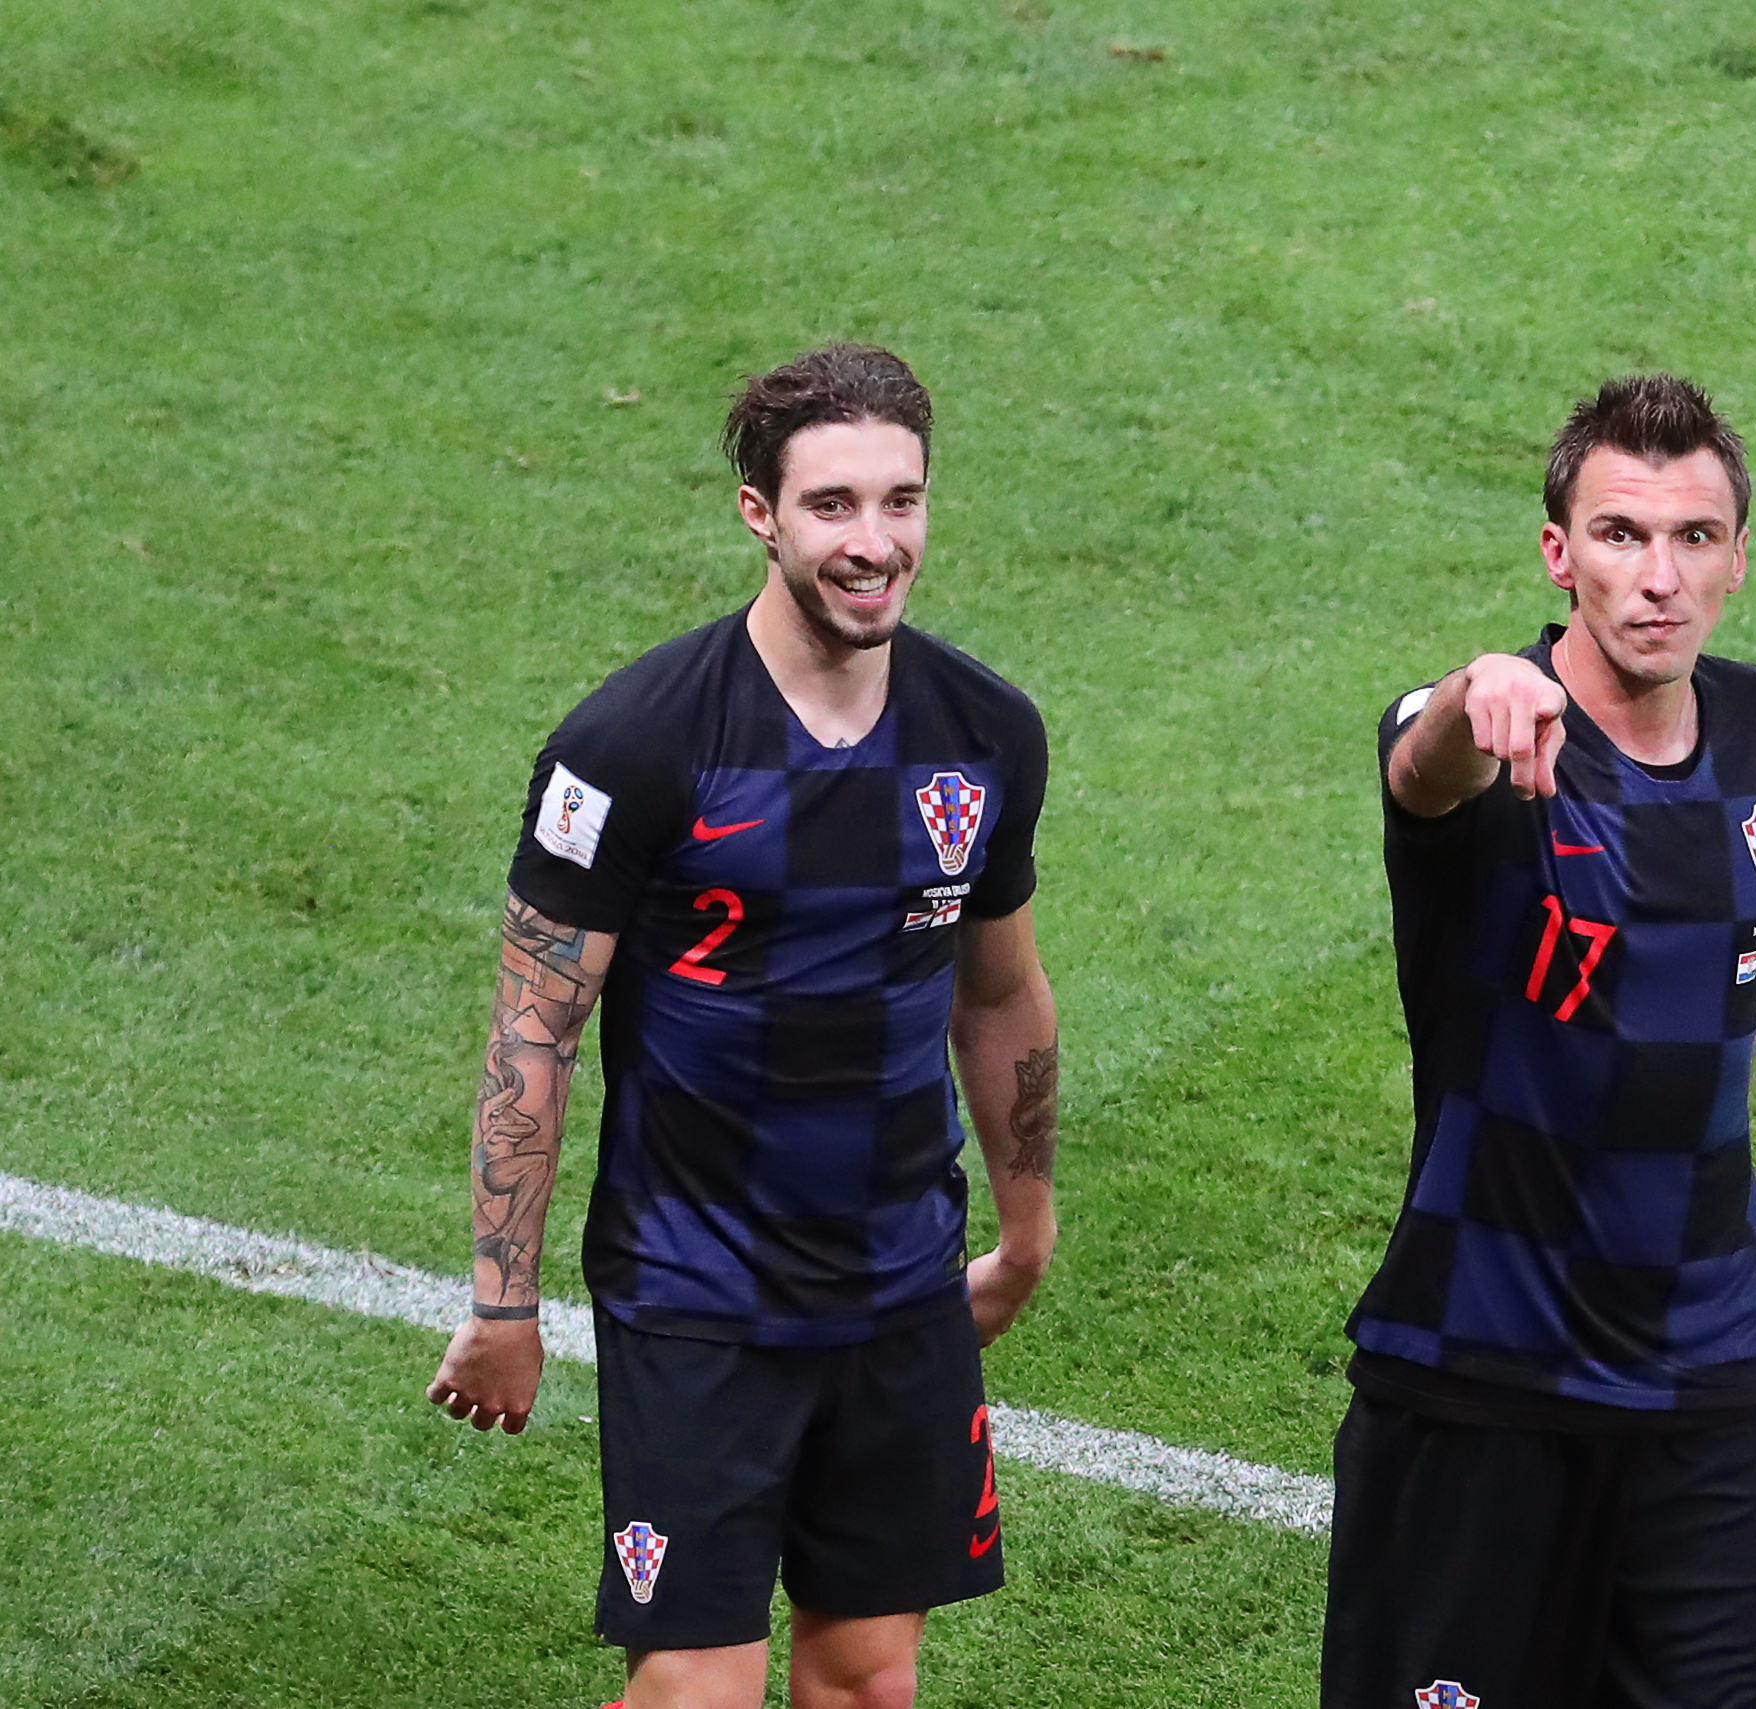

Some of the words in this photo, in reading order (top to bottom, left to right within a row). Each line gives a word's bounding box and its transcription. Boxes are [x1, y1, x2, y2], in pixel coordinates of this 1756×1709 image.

[668, 888, 744, 986] 2
[1526, 894, 1618, 1022] 17
[970, 1404, 999, 1518] 2
